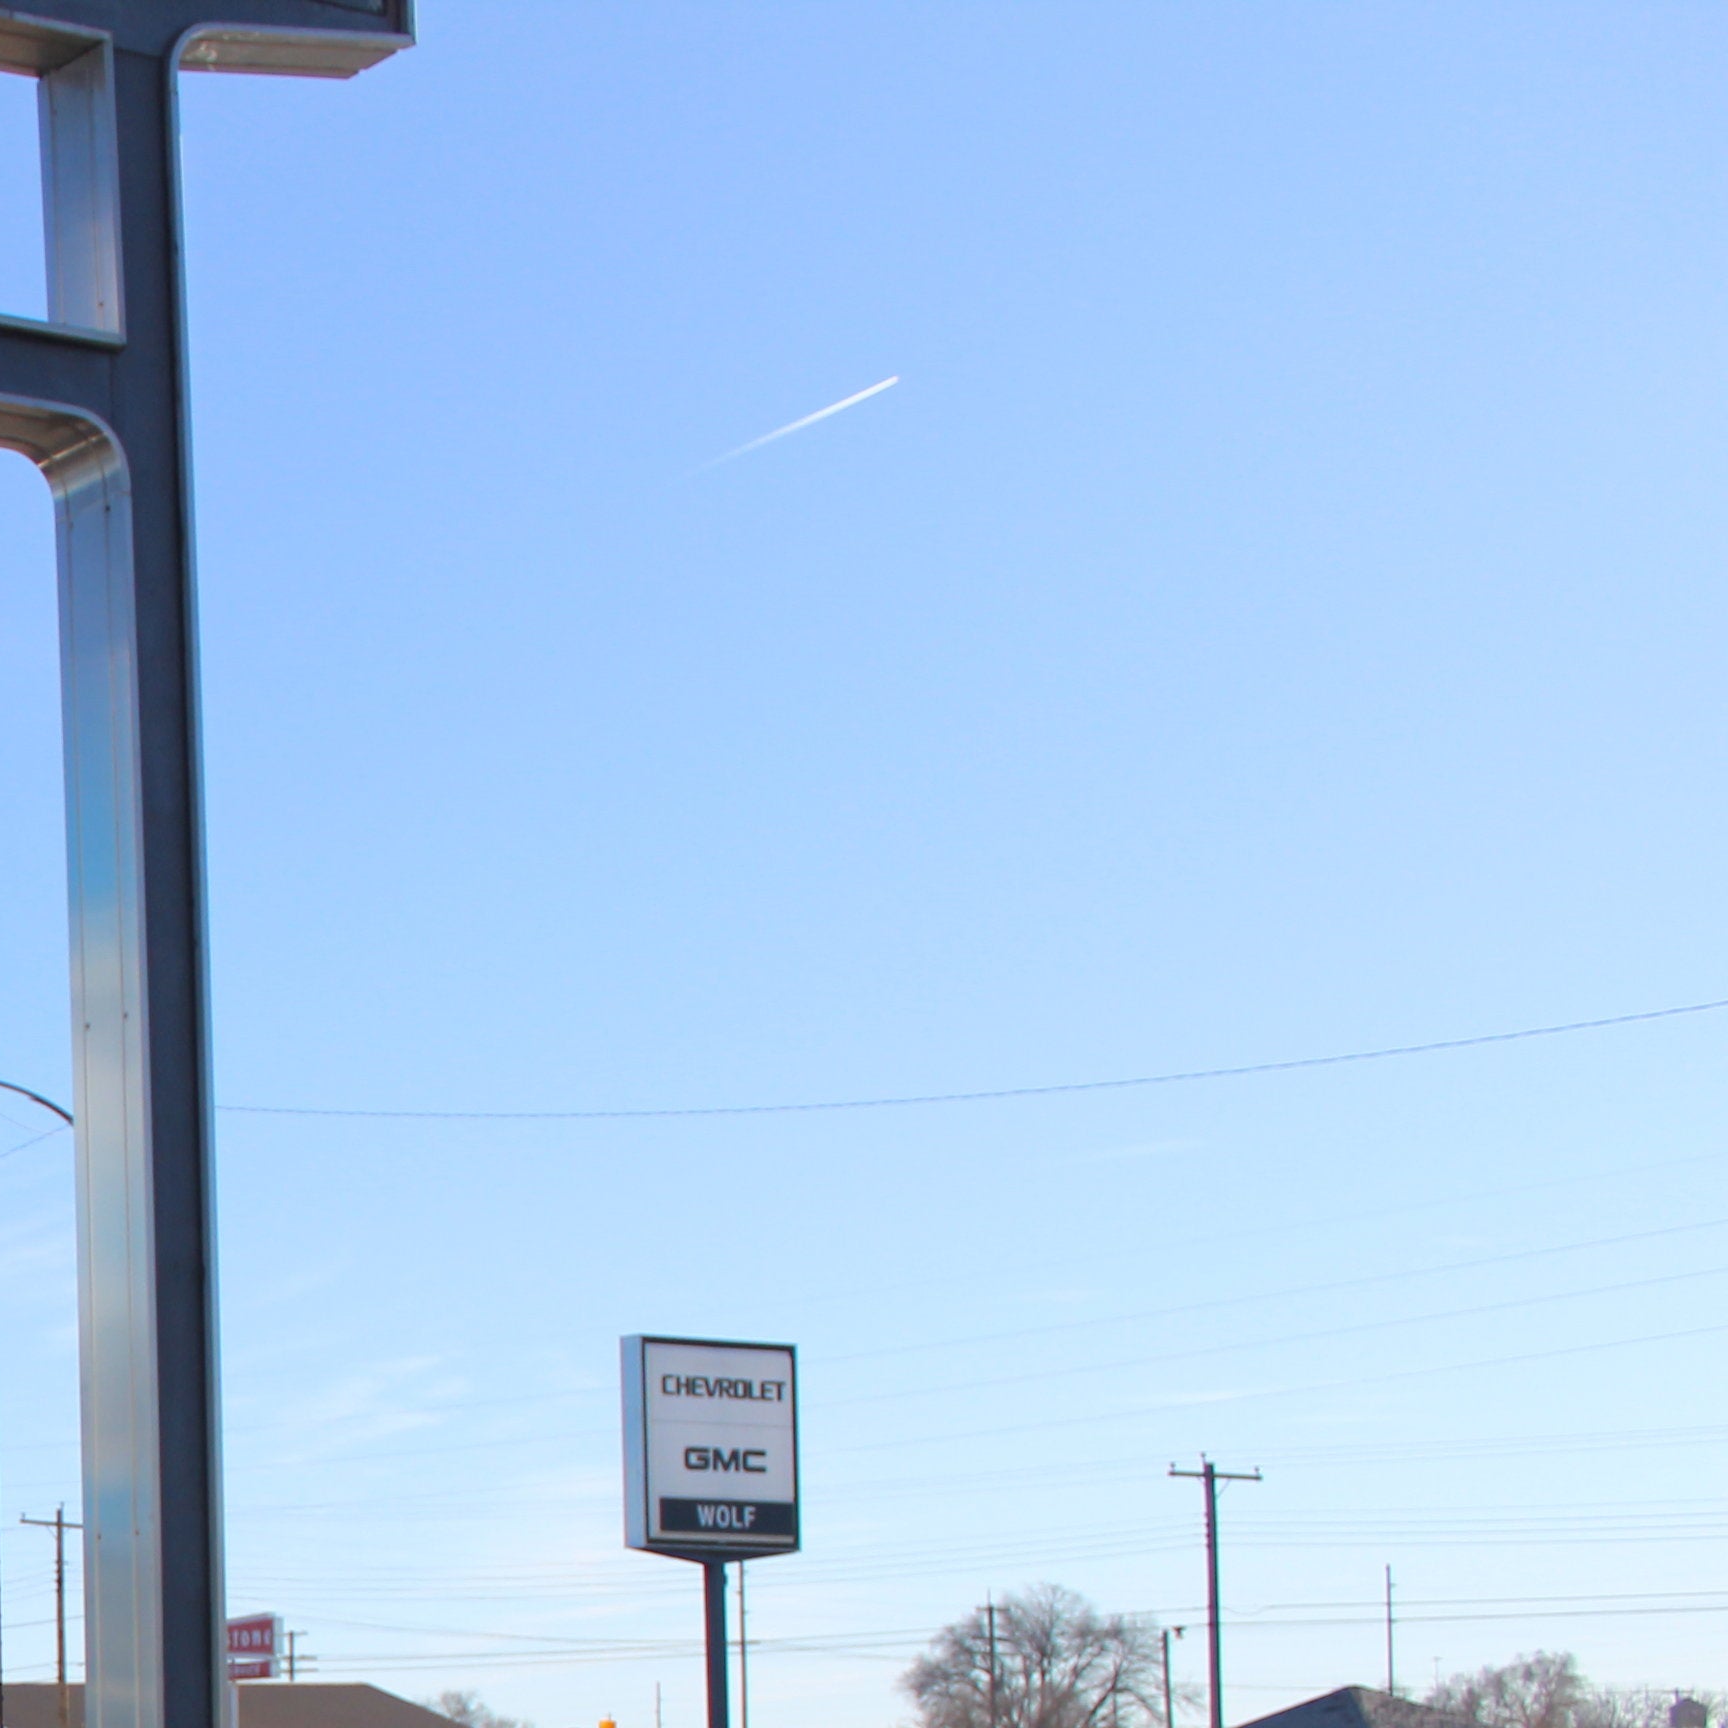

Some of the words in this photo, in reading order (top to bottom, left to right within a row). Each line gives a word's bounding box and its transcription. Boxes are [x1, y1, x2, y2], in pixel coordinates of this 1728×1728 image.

[661, 1374, 786, 1401] CHEVROLET
[684, 1446, 767, 1473] GMC
[697, 1504, 756, 1528] WOLF
